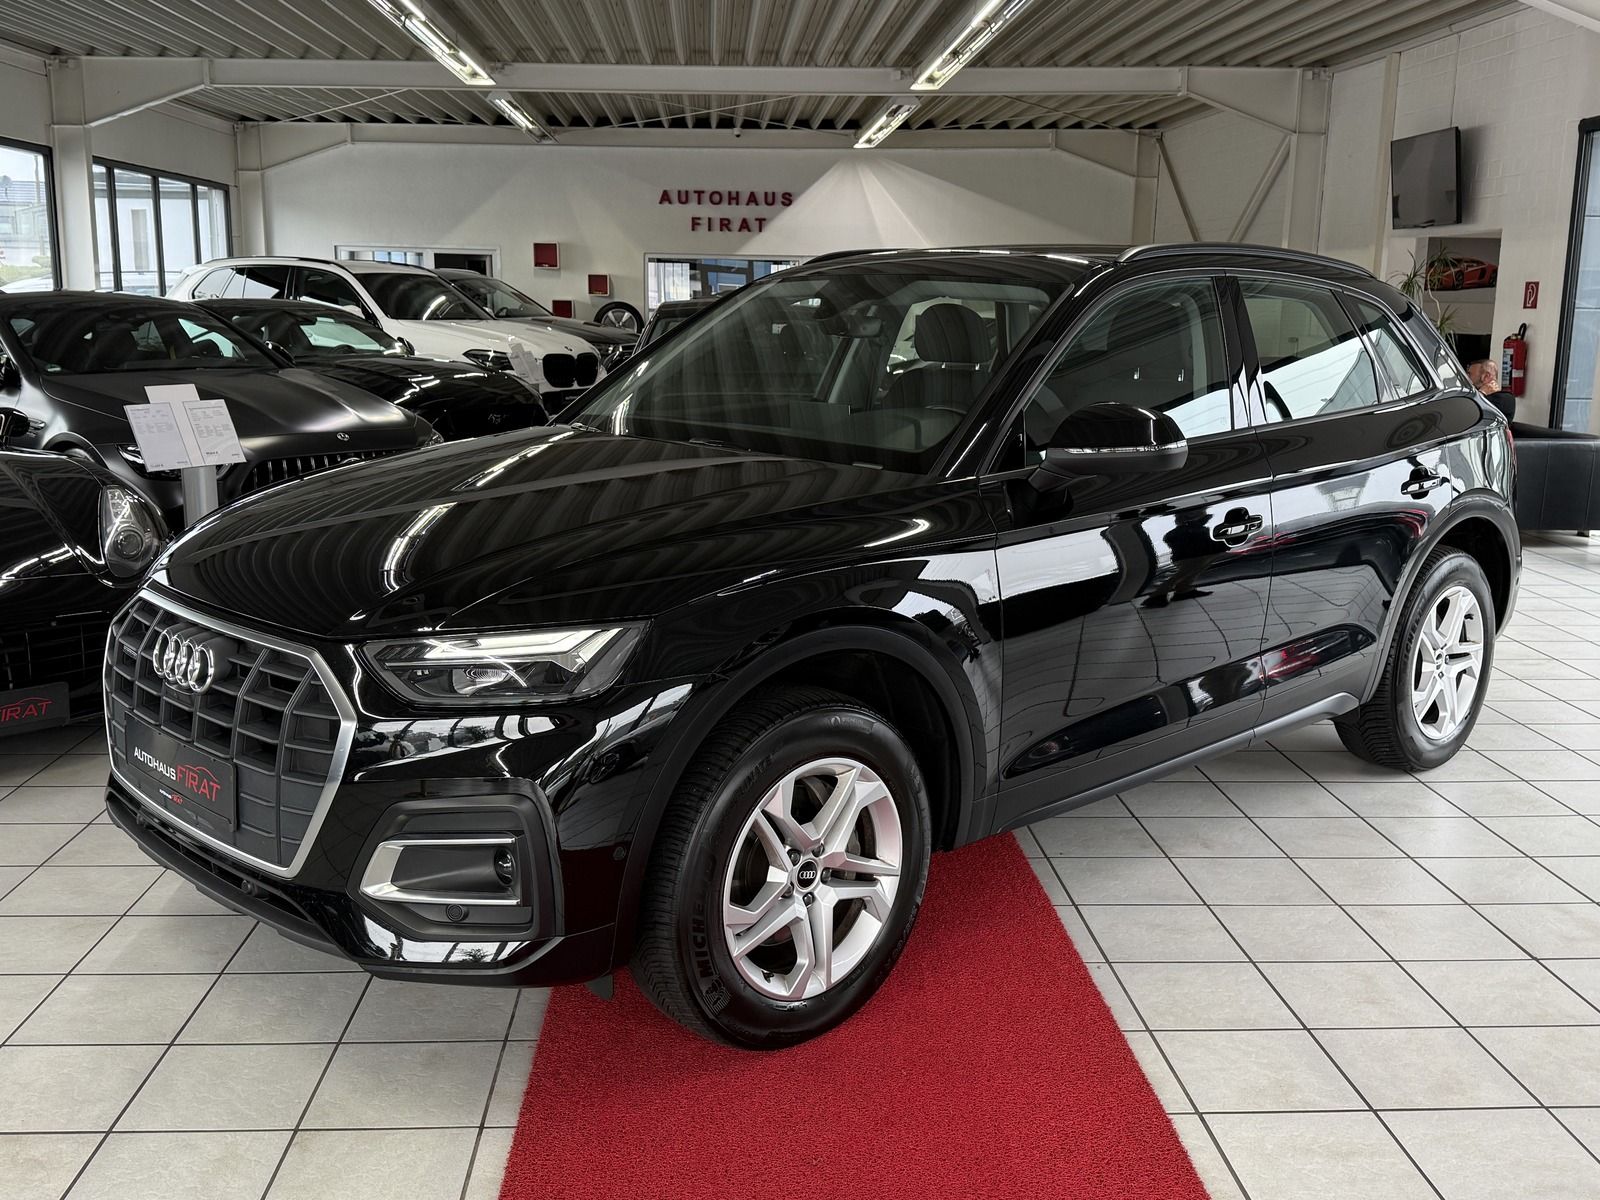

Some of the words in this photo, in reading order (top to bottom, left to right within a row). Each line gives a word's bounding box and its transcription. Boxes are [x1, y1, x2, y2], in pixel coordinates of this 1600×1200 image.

[659, 189, 793, 207] AUTOHAUS
[691, 217, 767, 232] FIRAT
[0, 701, 53, 722] IRAT
[134, 746, 176, 781] AUTOHAUS
[176, 764, 221, 801] FIRAT
